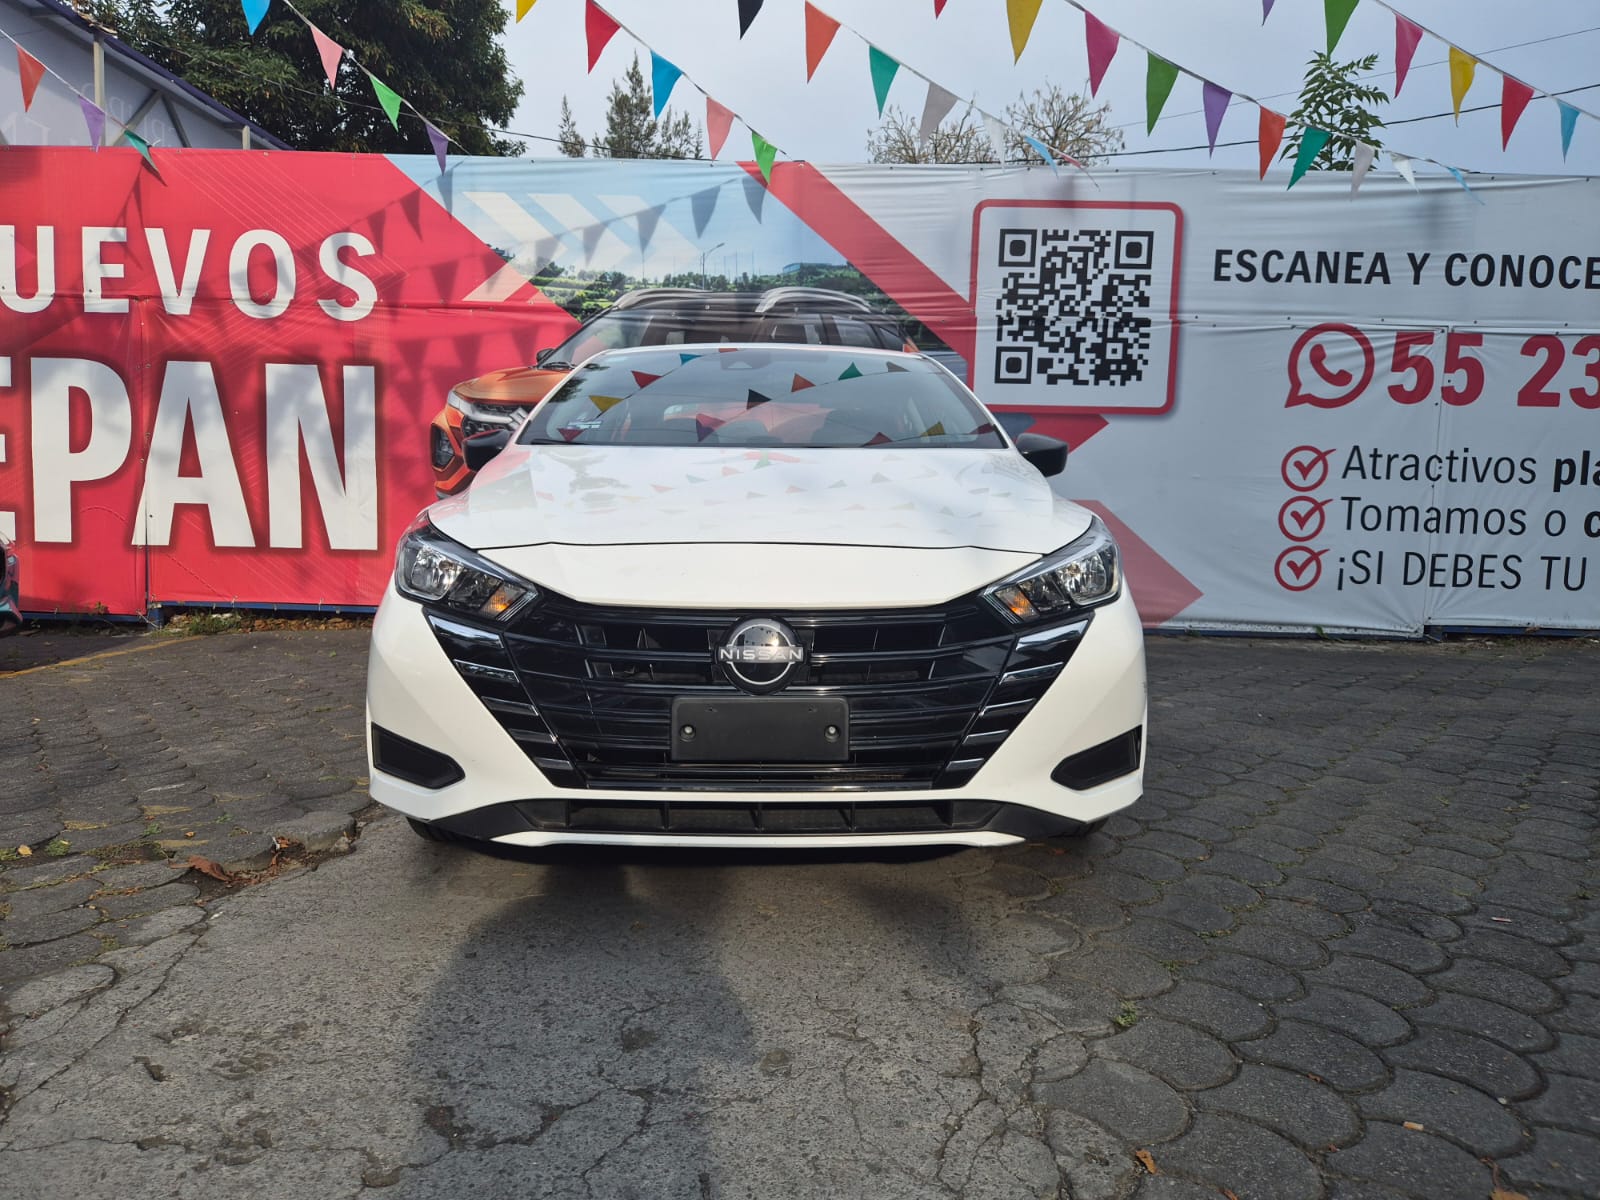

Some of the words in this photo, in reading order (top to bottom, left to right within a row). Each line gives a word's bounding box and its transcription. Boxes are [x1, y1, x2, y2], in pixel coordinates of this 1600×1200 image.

[0, 224, 378, 322] UEVOS
[1213, 249, 1391, 285] ESCANEA
[1408, 252, 1431, 285] Y
[1445, 254, 1600, 289] CONOCE
[1387, 331, 1484, 406] 55
[1517, 334, 1600, 409] 23
[0, 357, 378, 550] PAN
[1342, 445, 1537, 484] Atractivos
[1341, 497, 1527, 535] Tomamos
[1544, 510, 1566, 537] o
[1337, 550, 1384, 591] ¡SI
[1403, 552, 1522, 590] DEBES
[1540, 555, 1587, 591] TU
[720, 648, 803, 661] NISSAN
